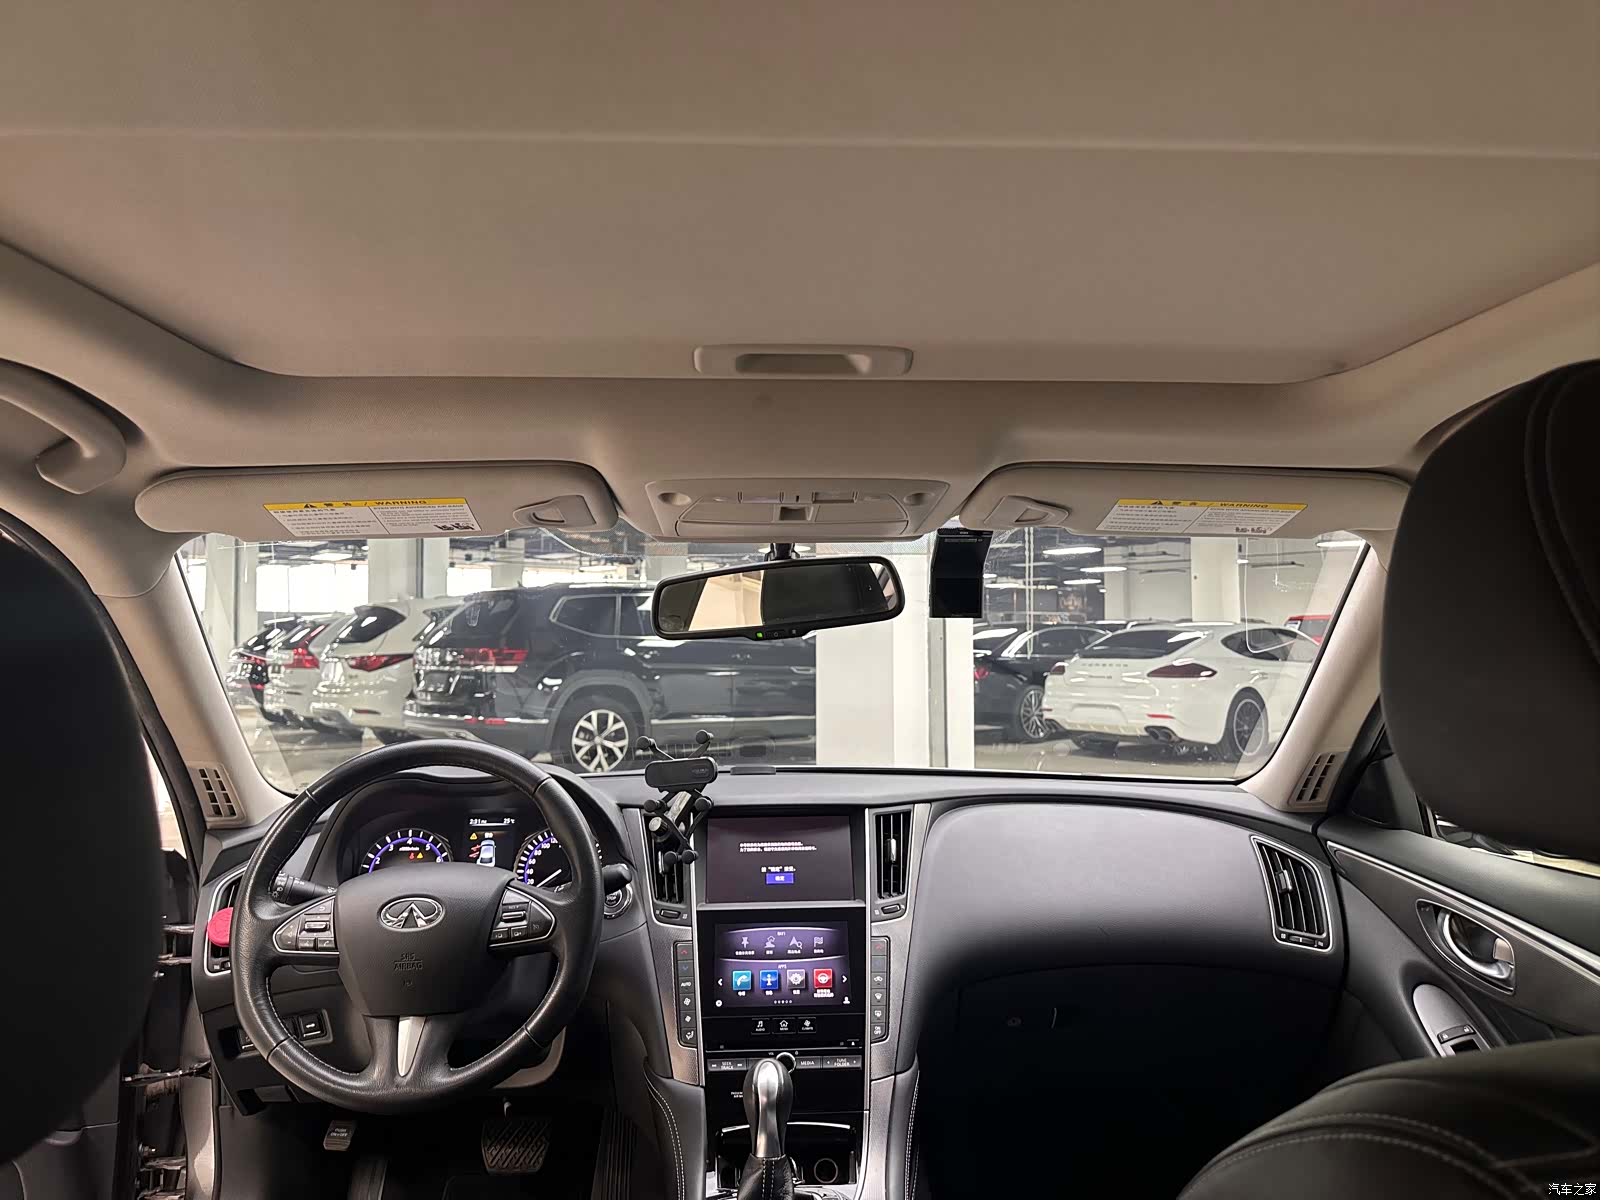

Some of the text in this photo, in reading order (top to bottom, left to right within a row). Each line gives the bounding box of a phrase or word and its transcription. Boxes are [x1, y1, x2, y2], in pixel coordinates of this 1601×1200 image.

[388, 843, 394, 851] 3
[425, 843, 431, 851] 5
[375, 857, 381, 865] 2
